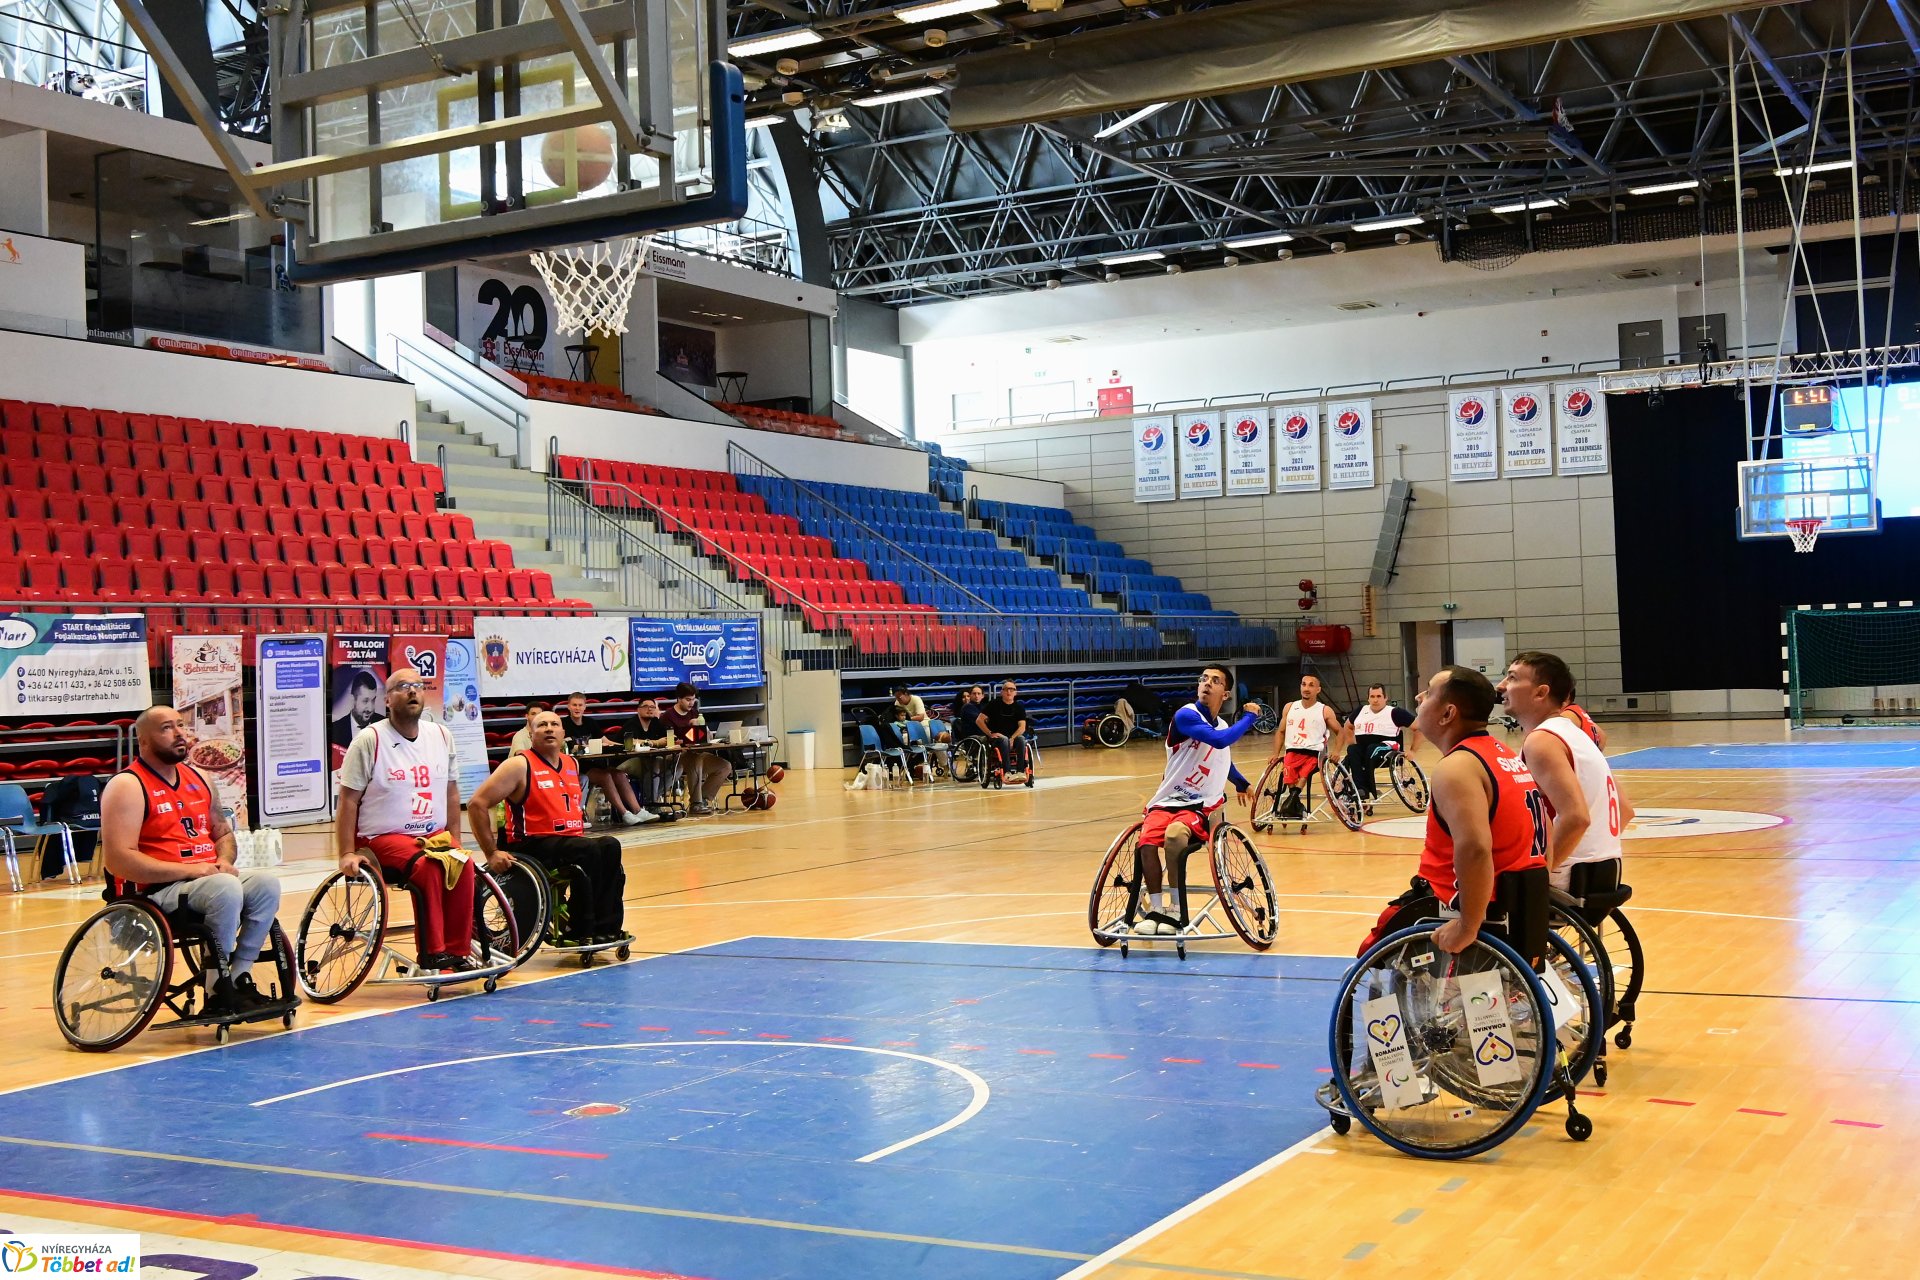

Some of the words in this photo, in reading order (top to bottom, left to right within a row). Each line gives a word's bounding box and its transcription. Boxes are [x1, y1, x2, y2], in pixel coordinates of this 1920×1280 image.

[653, 251, 686, 268] Eissmann
[478, 279, 547, 353] 20
[87, 328, 125, 340] ontinental
[158, 337, 200, 350] Continental
[230, 348, 270, 360] Continental
[1514, 457, 1545, 466] HELYEZÉS
[85, 622, 130, 631] Rehabilitációs
[54, 632, 97, 641] Foglalkoztató
[98, 633, 128, 641] Nonprofit
[347, 650, 377, 658] ZOLTÁN
[516, 647, 596, 664] NYÍREGYHÁZA
[672, 642, 704, 659] Oplus
[28, 668, 45, 677] 4400
[48, 667, 97, 678] Nyíregyháza,
[98, 666, 114, 676] Árok
[124, 667, 134, 675] 15.
[28, 681, 41, 689] +36
[70, 680, 86, 689] 433,
[28, 692, 120, 703] titkarsag@startrehab.hu
[1298, 718, 1305, 730] 4
[1364, 723, 1374, 733] 10
[410, 765, 430, 788] 18
[1606, 776, 1619, 837] 6
[1525, 789, 1547, 858] 10
[1473, 1023, 1506, 1033] ROMANIAN
[1375, 1045, 1405, 1057] ROMANIAN
